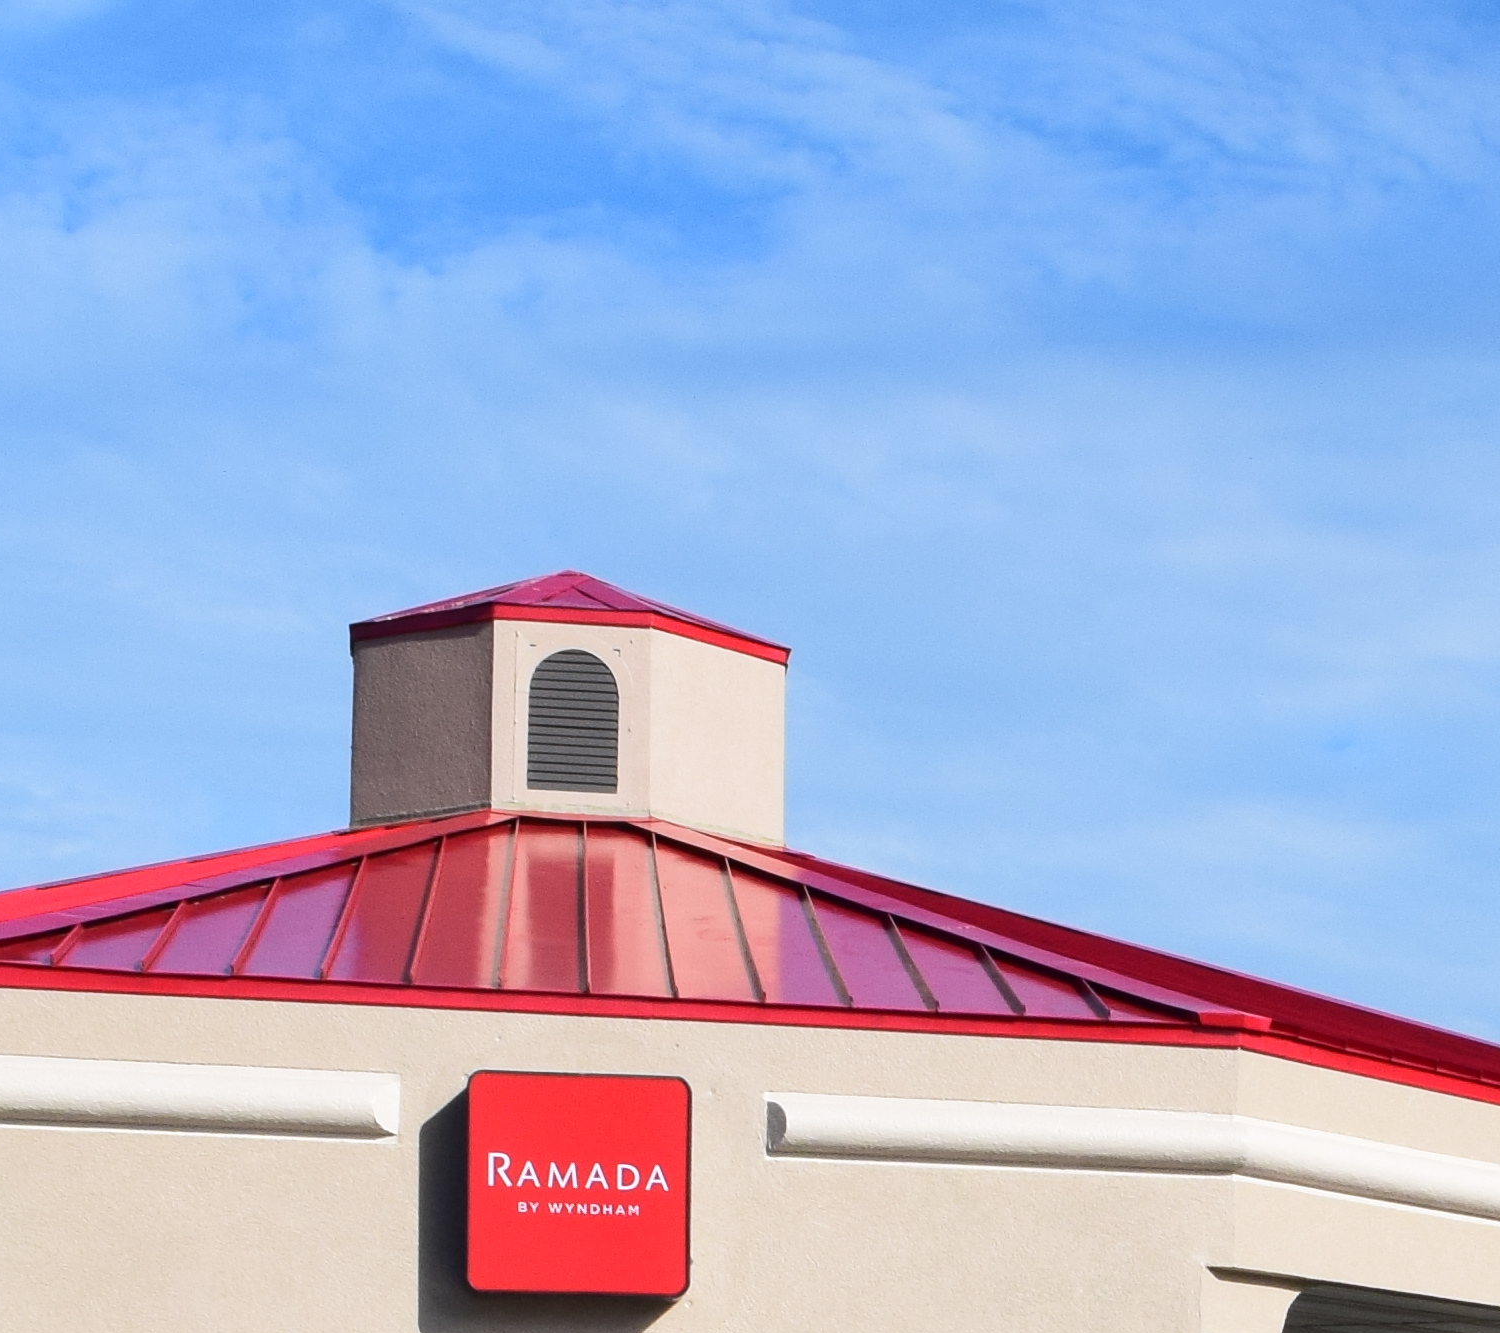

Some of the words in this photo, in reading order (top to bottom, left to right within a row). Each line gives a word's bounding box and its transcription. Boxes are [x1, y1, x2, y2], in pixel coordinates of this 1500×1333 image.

[486, 1152, 669, 1191] RAMADA
[517, 1202, 539, 1213] BY
[548, 1203, 640, 1216] WYNDHAM
